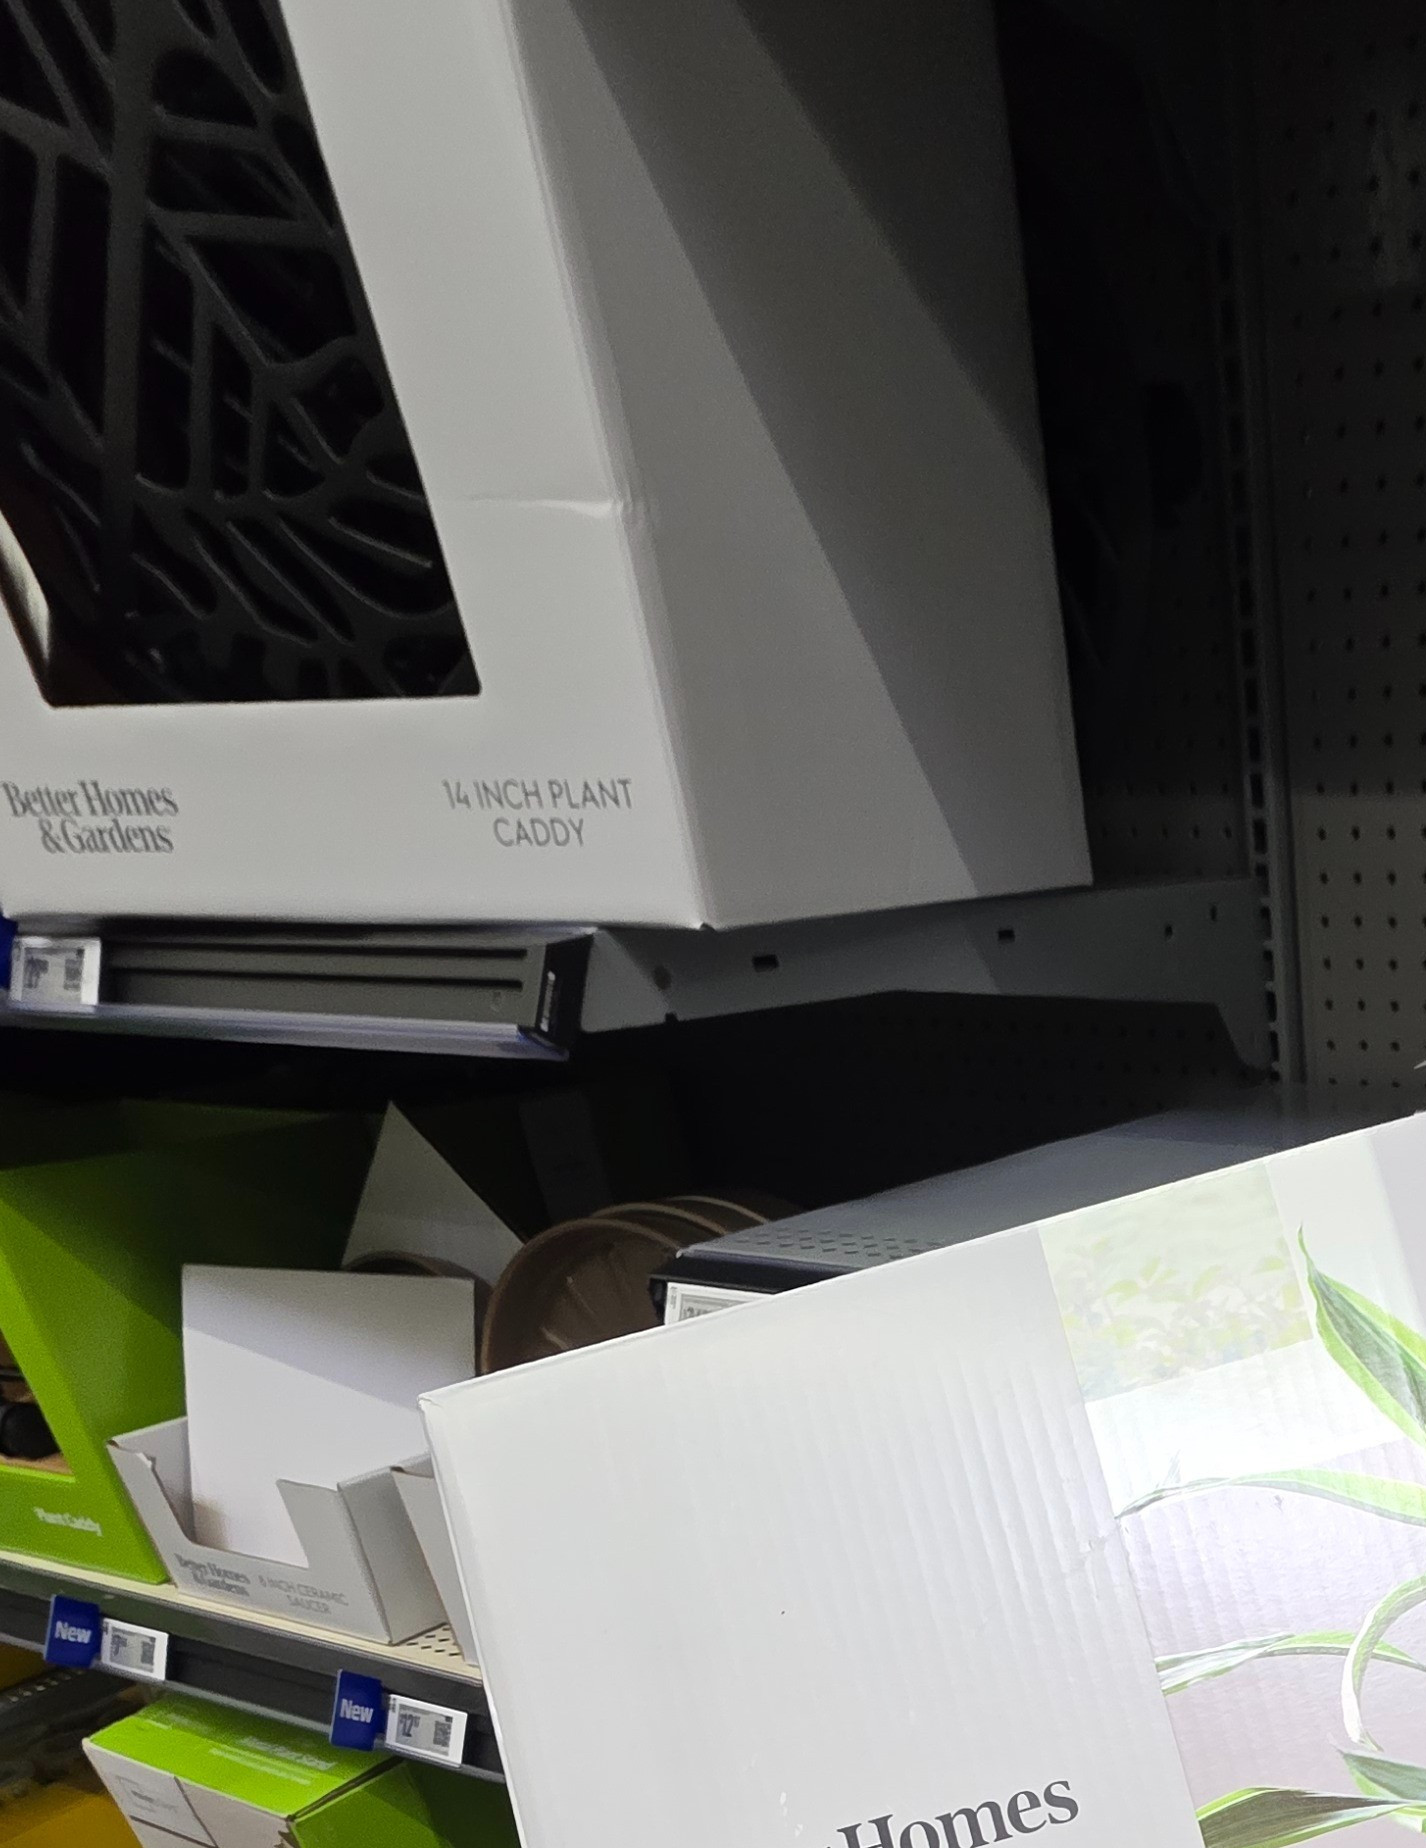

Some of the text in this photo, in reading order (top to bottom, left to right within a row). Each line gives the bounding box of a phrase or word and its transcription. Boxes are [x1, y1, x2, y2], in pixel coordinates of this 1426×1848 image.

[1, 779, 179, 817] Better Homes
[442, 778, 632, 810] 14 INCH PLANT
[493, 816, 584, 847] CADDY
[54, 1620, 93, 1645] New
[340, 1698, 374, 1724] New
